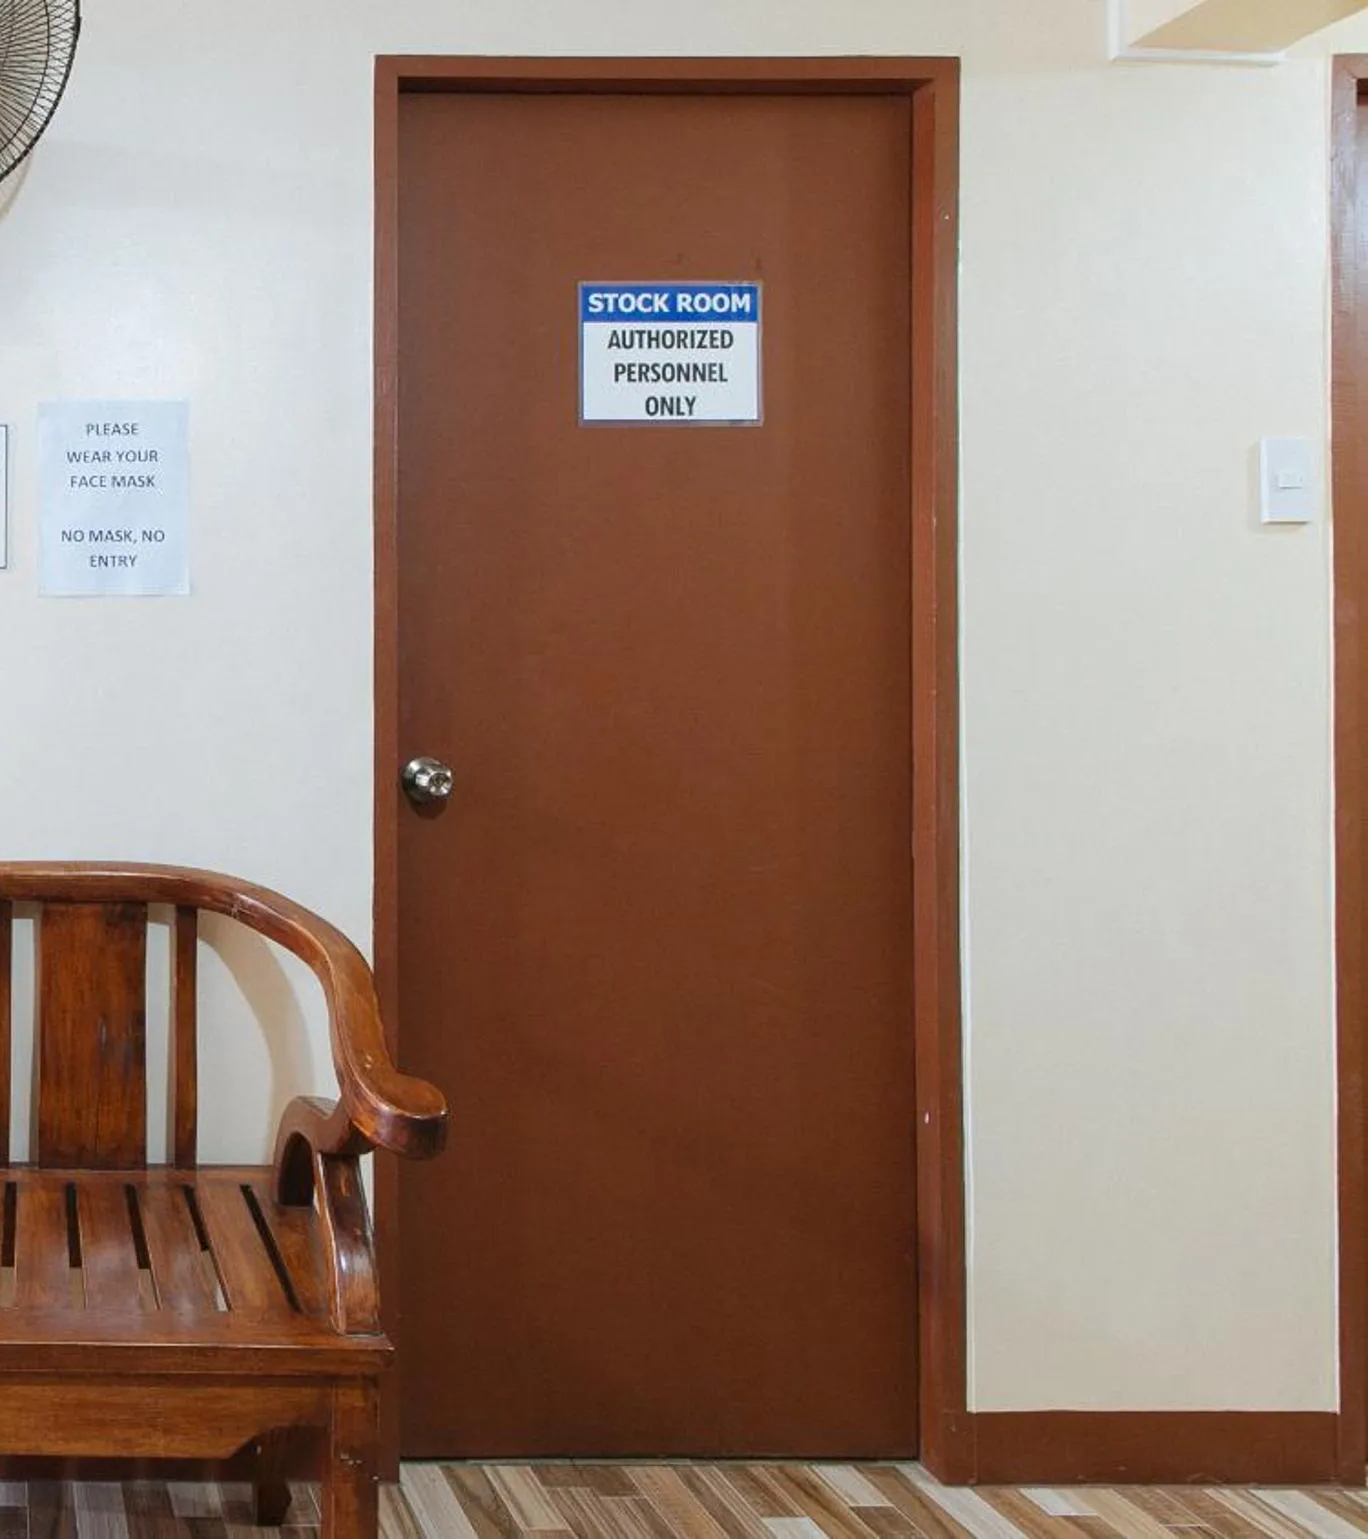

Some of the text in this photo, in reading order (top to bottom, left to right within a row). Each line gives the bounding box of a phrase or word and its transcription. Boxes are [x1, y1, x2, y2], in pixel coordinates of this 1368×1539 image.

[588, 292, 751, 313] STOCK ROOM
[607, 329, 734, 349] AUTHORIZED
[614, 362, 728, 383] PERSONNEL
[645, 396, 696, 416] ONLY
[86, 422, 139, 436] PLEASE
[66, 449, 159, 463] WEAR YOUR
[70, 475, 156, 488] FACE MASK
[61, 529, 165, 545] NO MASK, NO
[90, 554, 137, 568] ENTRY
